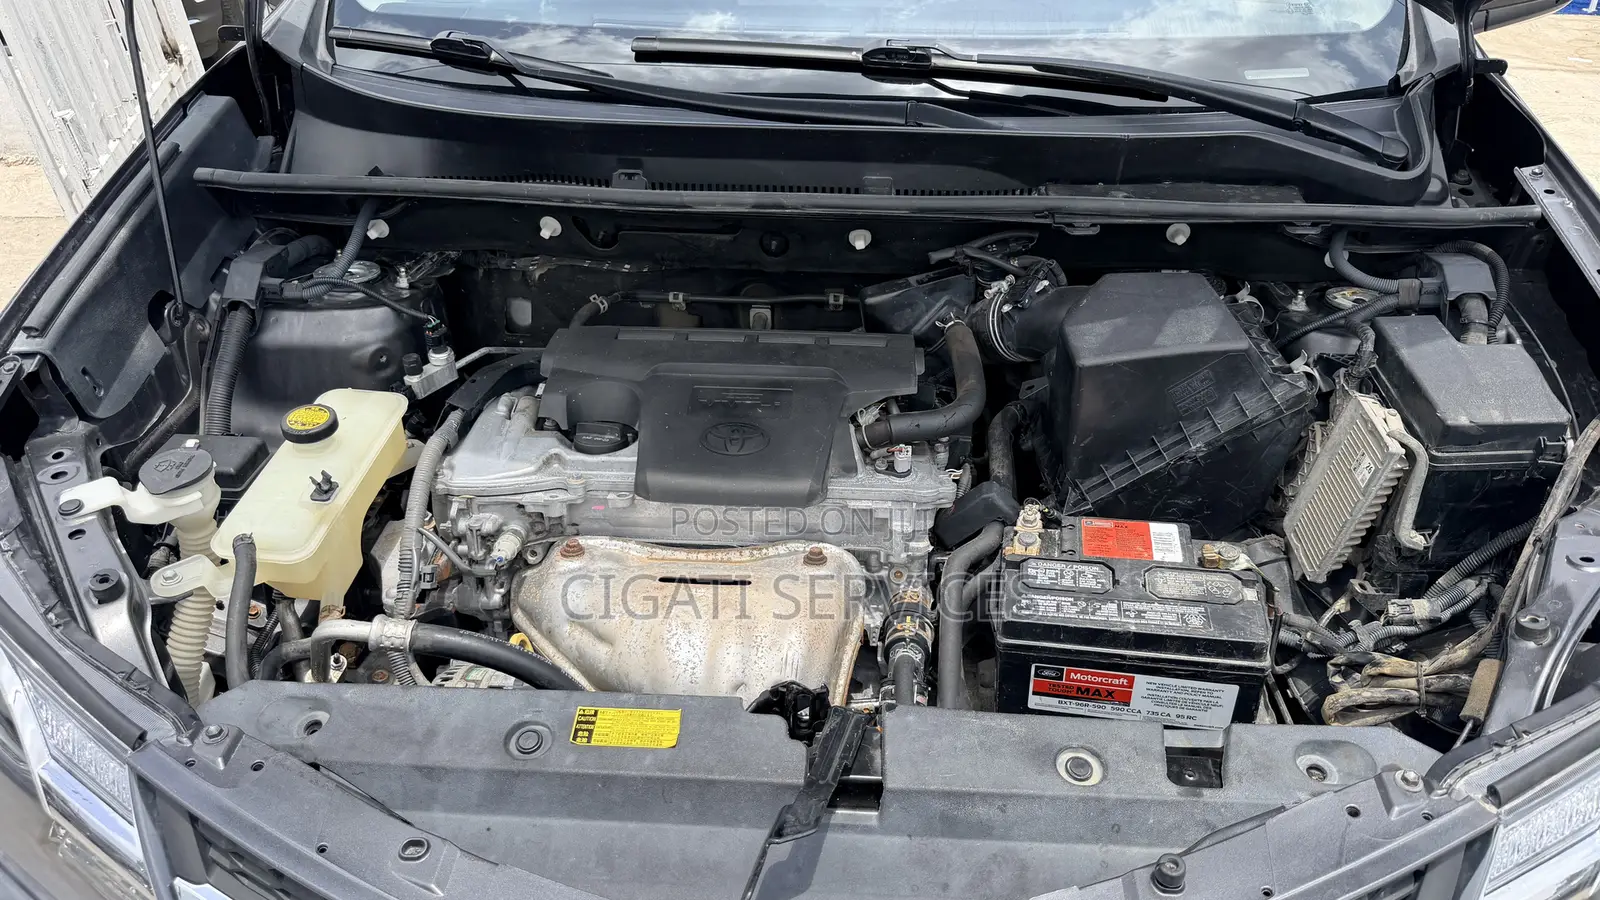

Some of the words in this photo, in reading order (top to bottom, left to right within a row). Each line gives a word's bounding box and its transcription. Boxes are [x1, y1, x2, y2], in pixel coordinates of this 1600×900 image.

[1070, 672, 1129, 686] Motorcraft
[1076, 687, 1115, 699] MAX
[1057, 700, 1107, 710] BXT-96R-590
